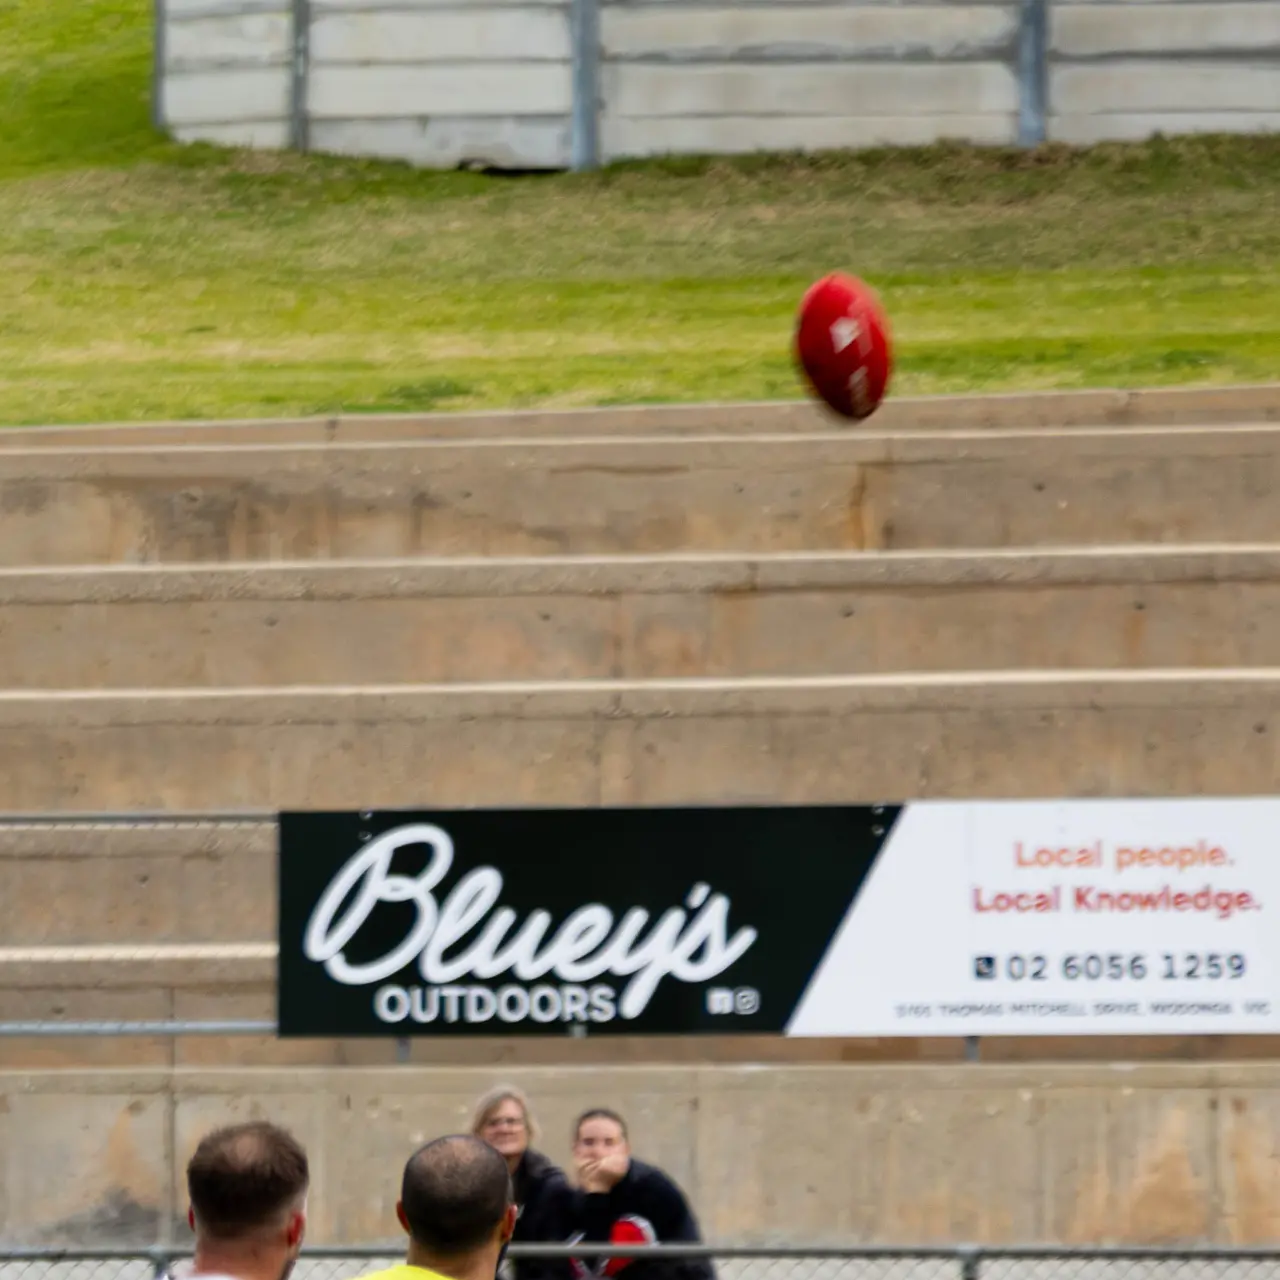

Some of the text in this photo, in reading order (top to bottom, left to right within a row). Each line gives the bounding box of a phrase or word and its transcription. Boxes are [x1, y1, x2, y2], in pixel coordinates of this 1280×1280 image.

[1014, 841, 1235, 872] Local people.
[973, 886, 1262, 920] Local Knowledge.
[304, 822, 759, 1020] Bluey's
[1007, 953, 1247, 981] 02 6056 1259
[374, 983, 617, 1024] OUTDOORS
